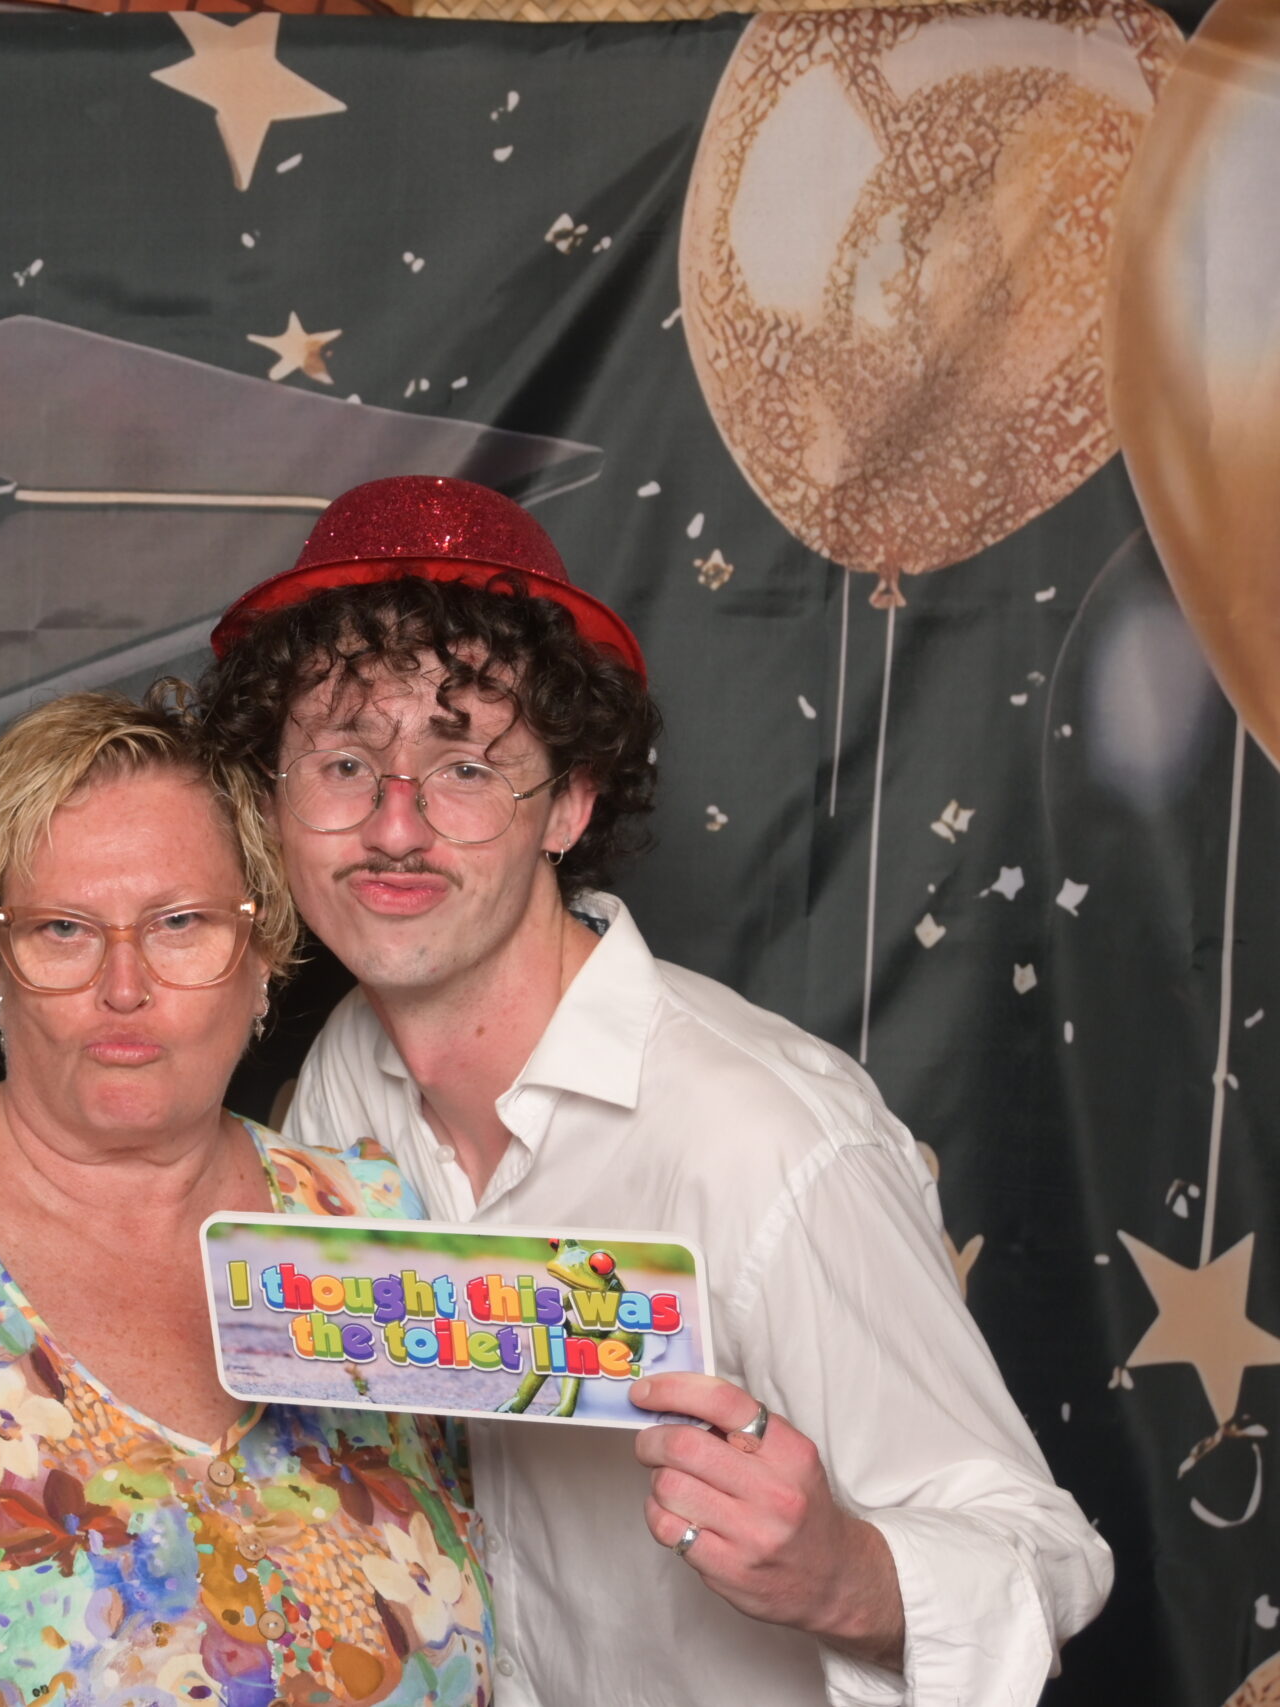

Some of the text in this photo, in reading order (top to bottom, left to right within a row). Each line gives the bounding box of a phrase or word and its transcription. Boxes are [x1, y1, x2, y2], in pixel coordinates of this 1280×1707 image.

[227, 1260, 682, 1333] I thought this was
[289, 1312, 642, 1379] the toilet line.
